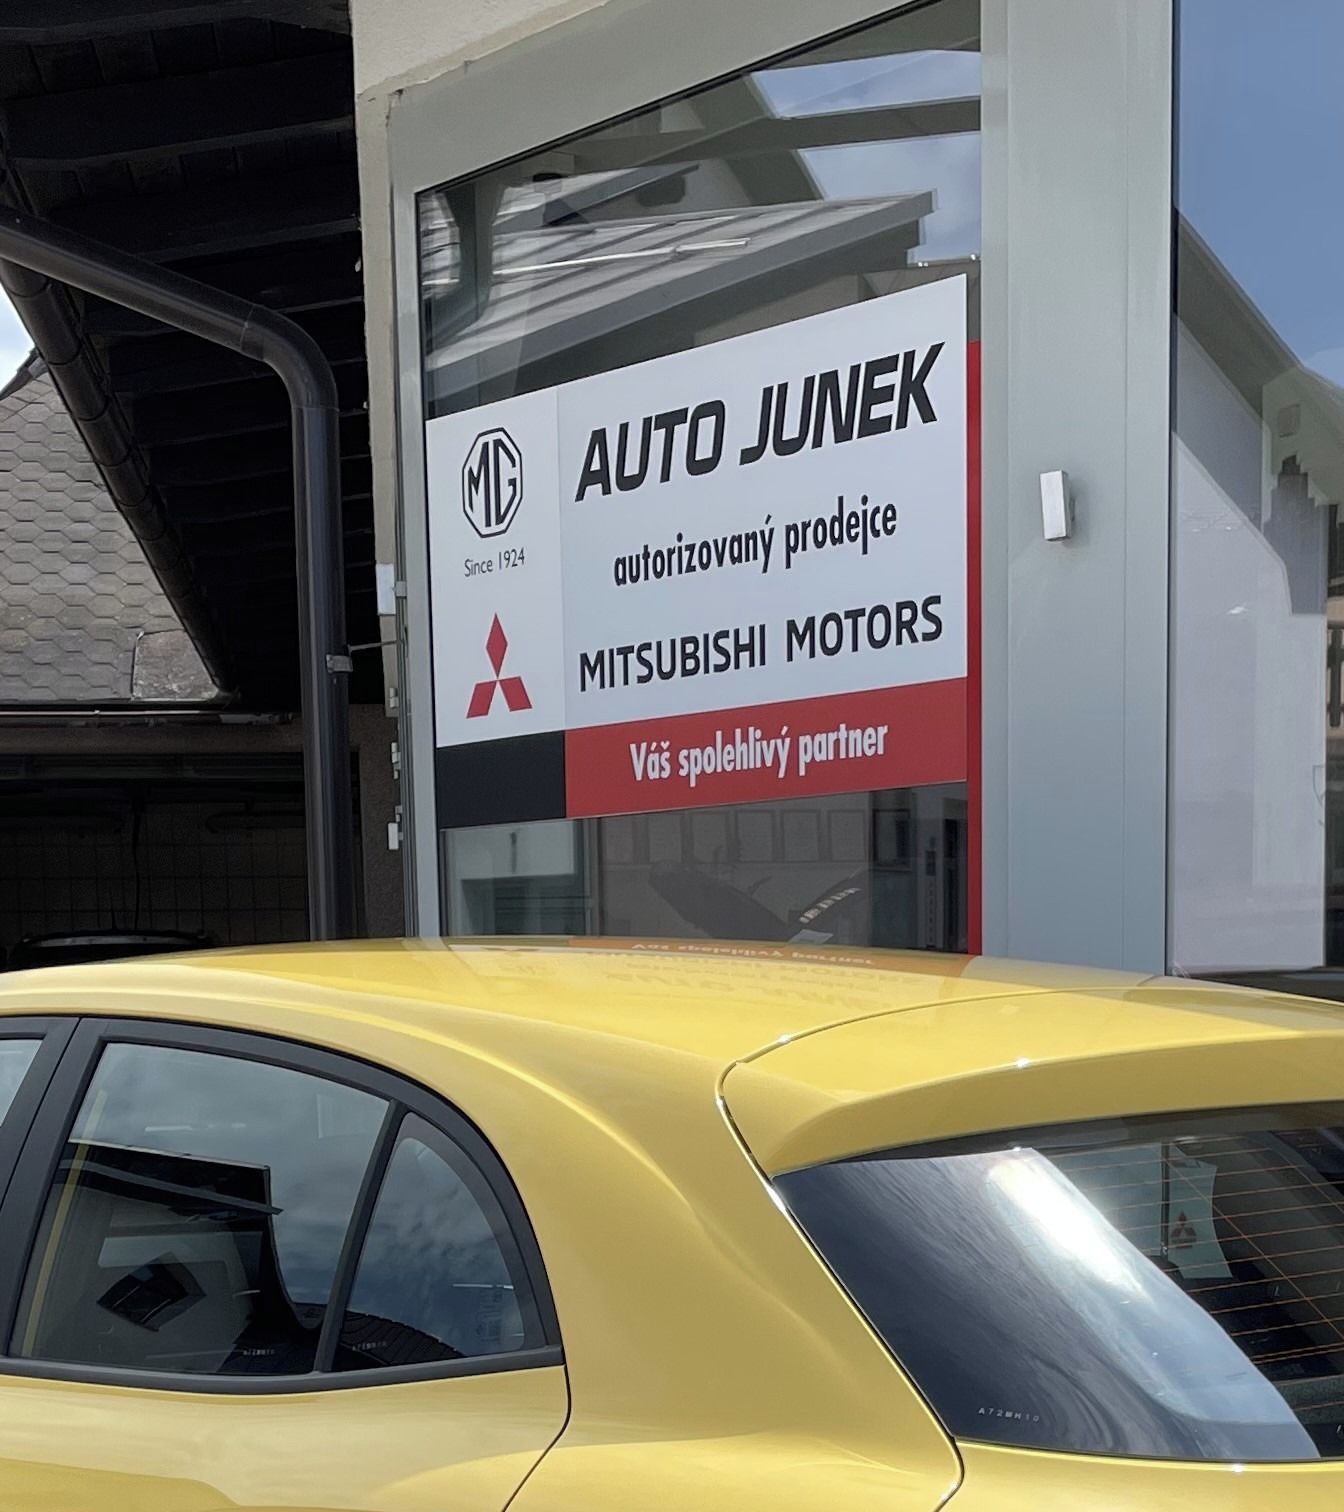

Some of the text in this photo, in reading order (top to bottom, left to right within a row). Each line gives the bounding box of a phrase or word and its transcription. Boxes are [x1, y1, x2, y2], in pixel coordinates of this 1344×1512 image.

[575, 342, 946, 502] AUTO JUNEK
[464, 432, 521, 534] MG
[464, 548, 526, 577] Since 1924
[613, 495, 897, 587] autorizovaný prodejce
[579, 595, 944, 692] MITSUBISHI MOTORS
[629, 722, 889, 787] Váš spolehlivý partner
